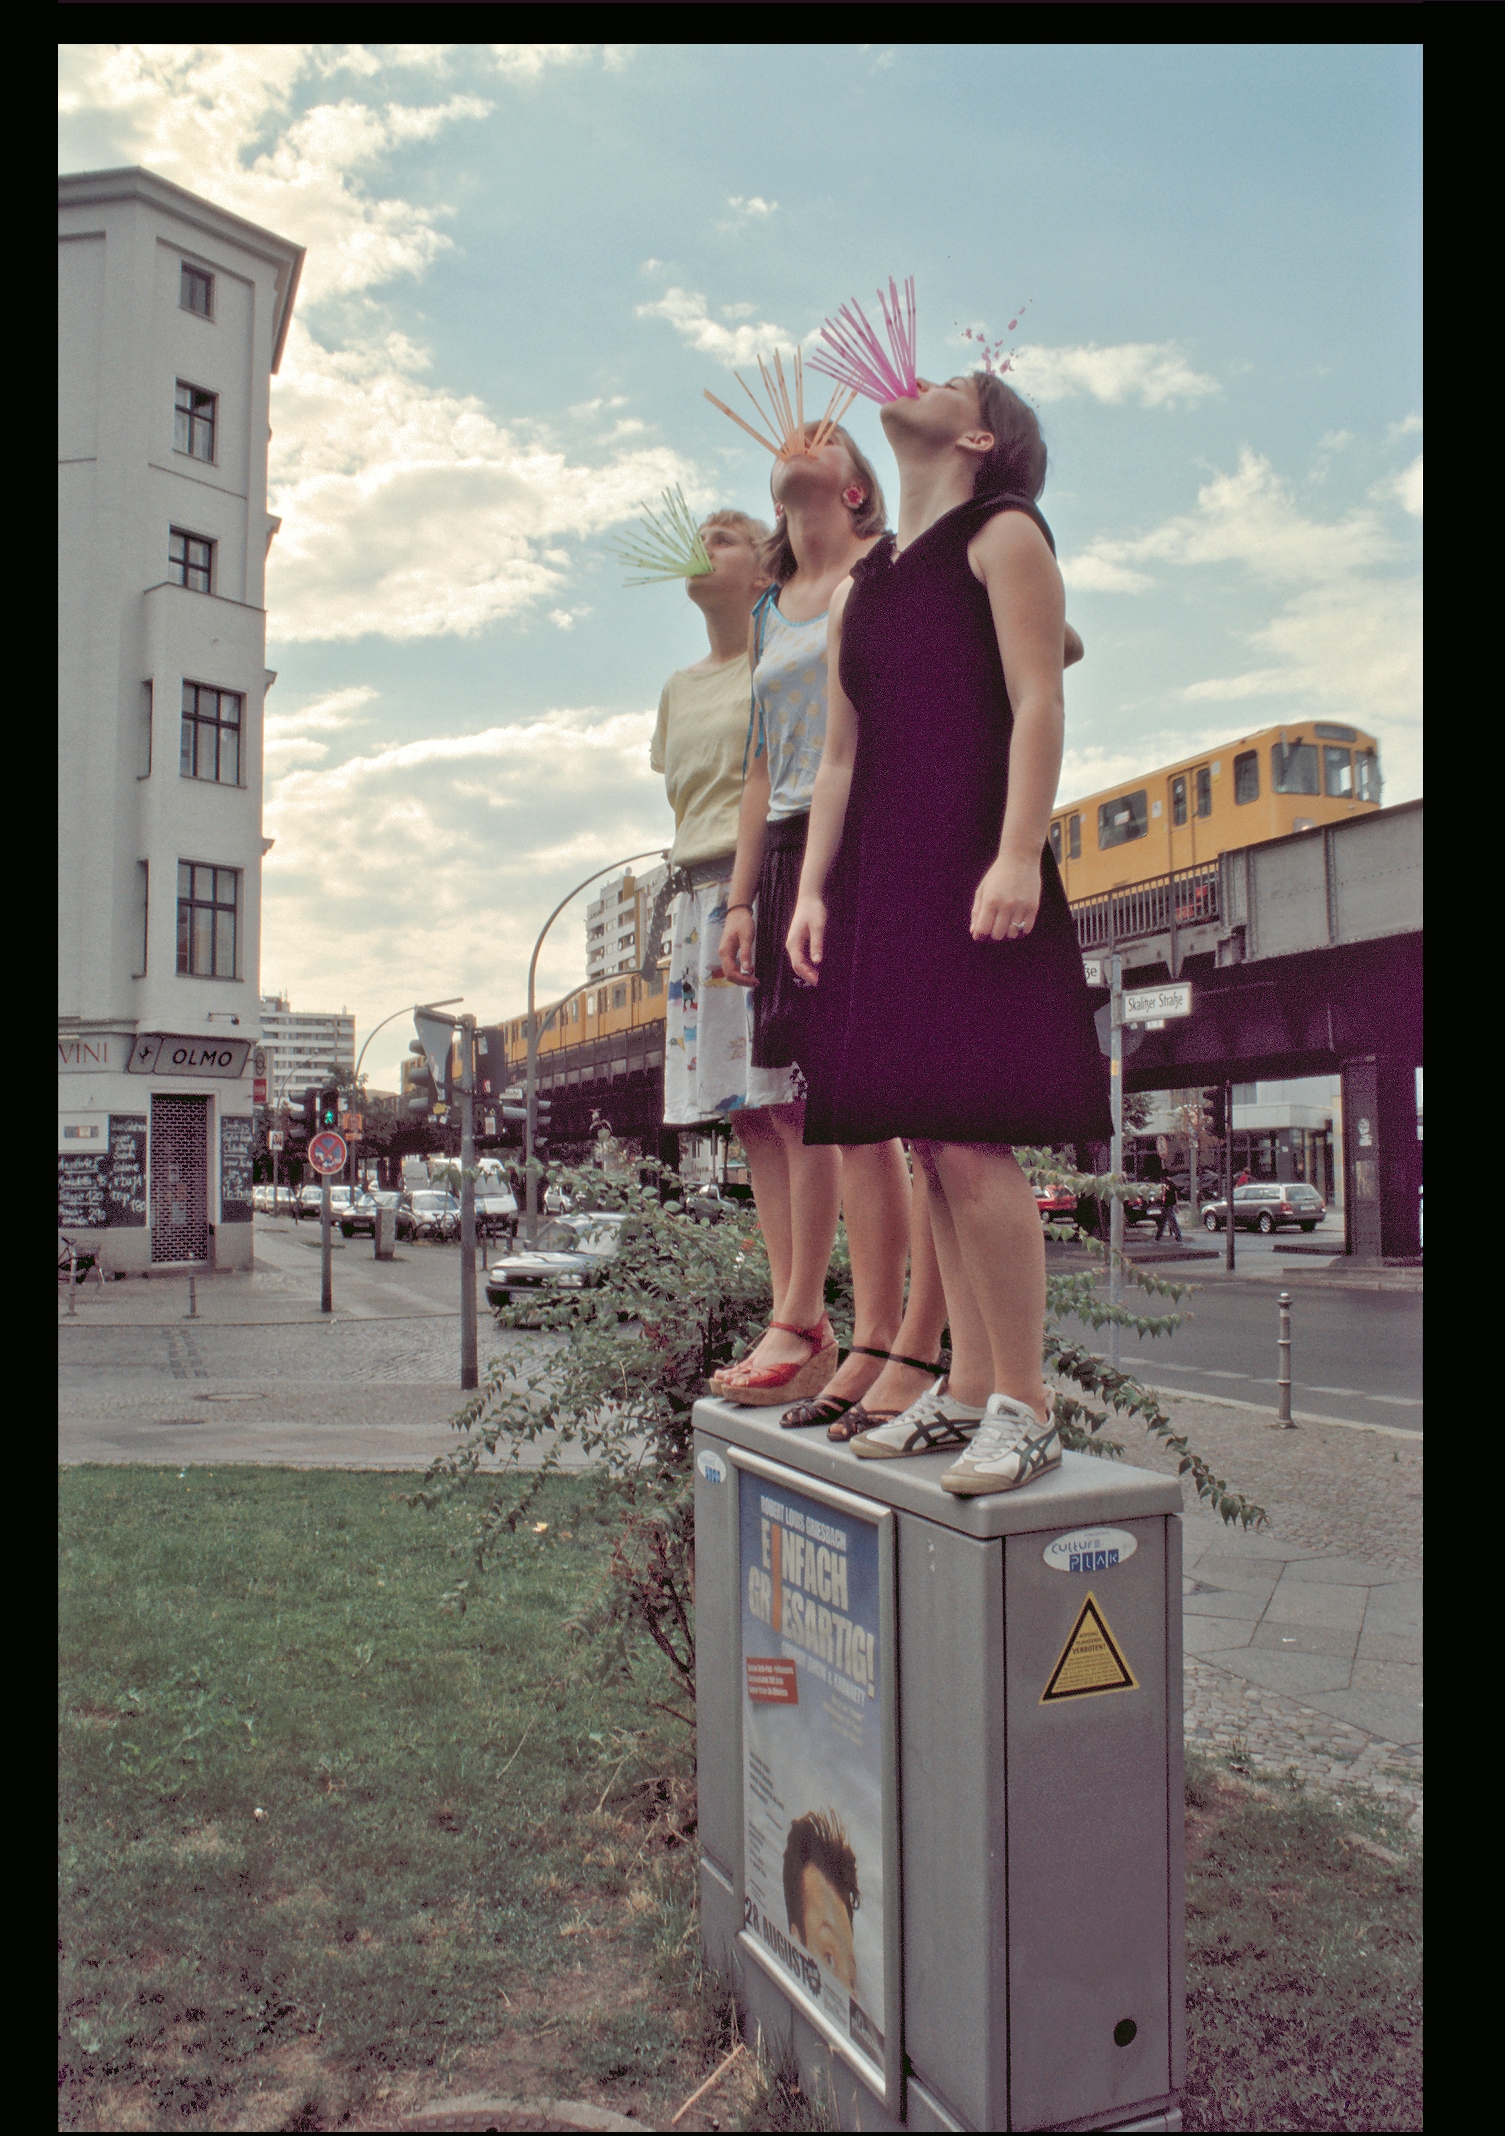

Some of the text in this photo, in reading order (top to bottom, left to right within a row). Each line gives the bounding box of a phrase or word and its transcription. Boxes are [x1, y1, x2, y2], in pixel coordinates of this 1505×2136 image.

[1158, 991, 1183, 1009] Straße
[58, 1042, 107, 1064] VINI
[172, 1048, 233, 1067] OLMO
[761, 1517, 849, 1613] EINFACH
[748, 1564, 875, 1700] GRIESARTIG!
[763, 1914, 807, 1984] AUGUST
